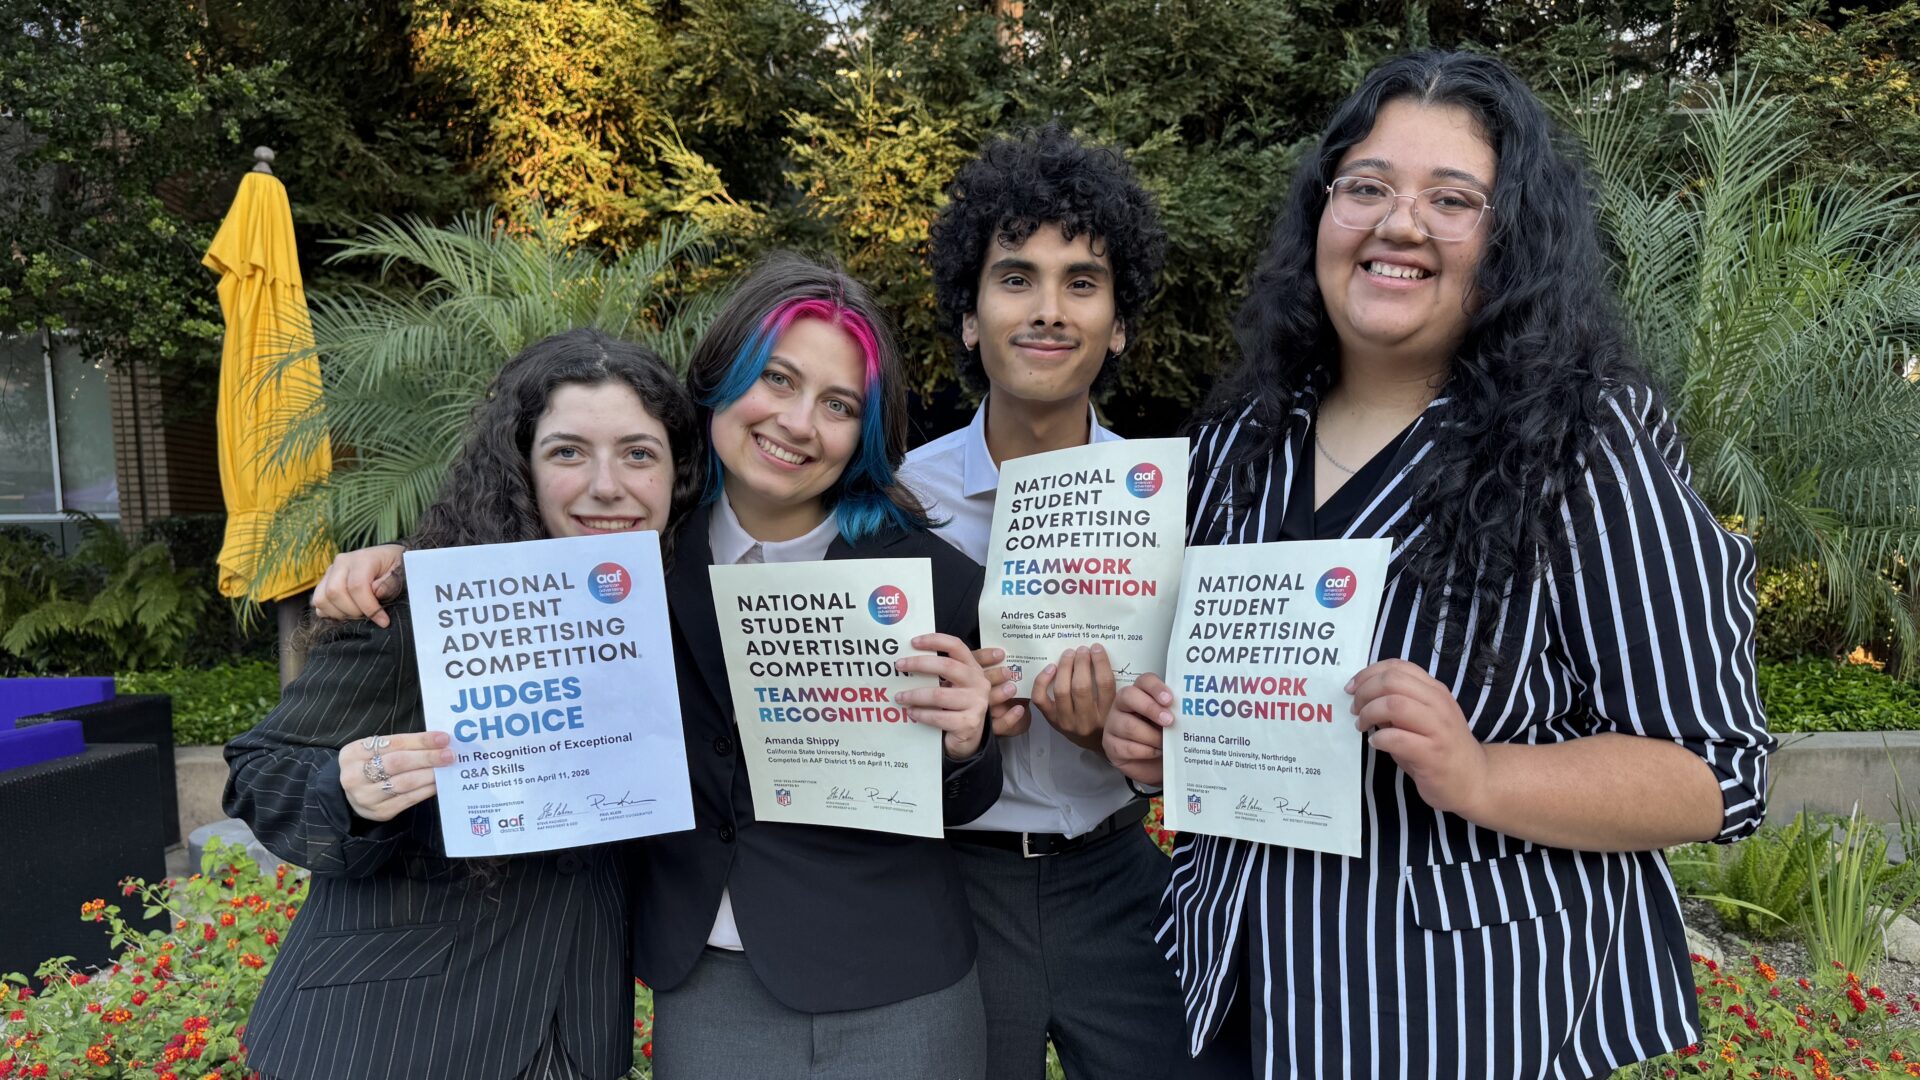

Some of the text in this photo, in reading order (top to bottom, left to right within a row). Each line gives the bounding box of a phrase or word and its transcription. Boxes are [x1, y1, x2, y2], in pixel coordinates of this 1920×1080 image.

[1014, 469, 1115, 495] NATIONAL
[1134, 470, 1156, 481] aaf
[1011, 490, 1103, 513] STUDENT
[1008, 510, 1151, 533] ADVERTISING
[1004, 558, 1132, 575] TEAMWORK
[596, 570, 622, 584] aaf
[1198, 573, 1305, 593] NATIONAL
[1325, 575, 1351, 588] aaf
[435, 572, 575, 603] NATIONAL
[1001, 579, 1156, 596] RECOGNITION
[737, 592, 856, 612] NATIONAL
[876, 593, 900, 605] aaf
[1194, 598, 1290, 616] STUDENT
[438, 598, 562, 628] STUDENT
[1001, 611, 1067, 619] Andres Casas
[741, 616, 844, 634] STUDENT
[1189, 622, 1335, 640] ADVERTISING
[442, 617, 625, 654] ADVERTISING
[746, 638, 899, 656] ADVERTISING
[1184, 675, 1308, 696] TEAMWORK
[450, 676, 582, 714] JUDGES
[754, 687, 890, 703] TEAMWORK
[1182, 698, 1333, 723] RECOGNITION
[453, 706, 585, 743] CHOICE
[458, 732, 633, 763] In Recognition of Exceptional
[765, 737, 840, 747] Amanda Shippy
[1184, 733, 1251, 746] Brianna Carrillo
[768, 757, 800, 765] Competed
[867, 760, 883, 768] April
[1184, 747, 1296, 763] California State University, Northridge
[461, 763, 525, 779] Q&A Skills
[1184, 757, 1213, 766] Competed
[1235, 761, 1257, 770] District
[1277, 765, 1293, 774] April
[1295, 767, 1304, 775] 11,
[462, 782, 479, 791] AAF
[482, 779, 512, 790] District
[513, 778, 523, 786] 15
[537, 773, 557, 784] April
[558, 771, 570, 781] 11,
[571, 769, 590, 778] 2026
[498, 814, 524, 828] aaf
